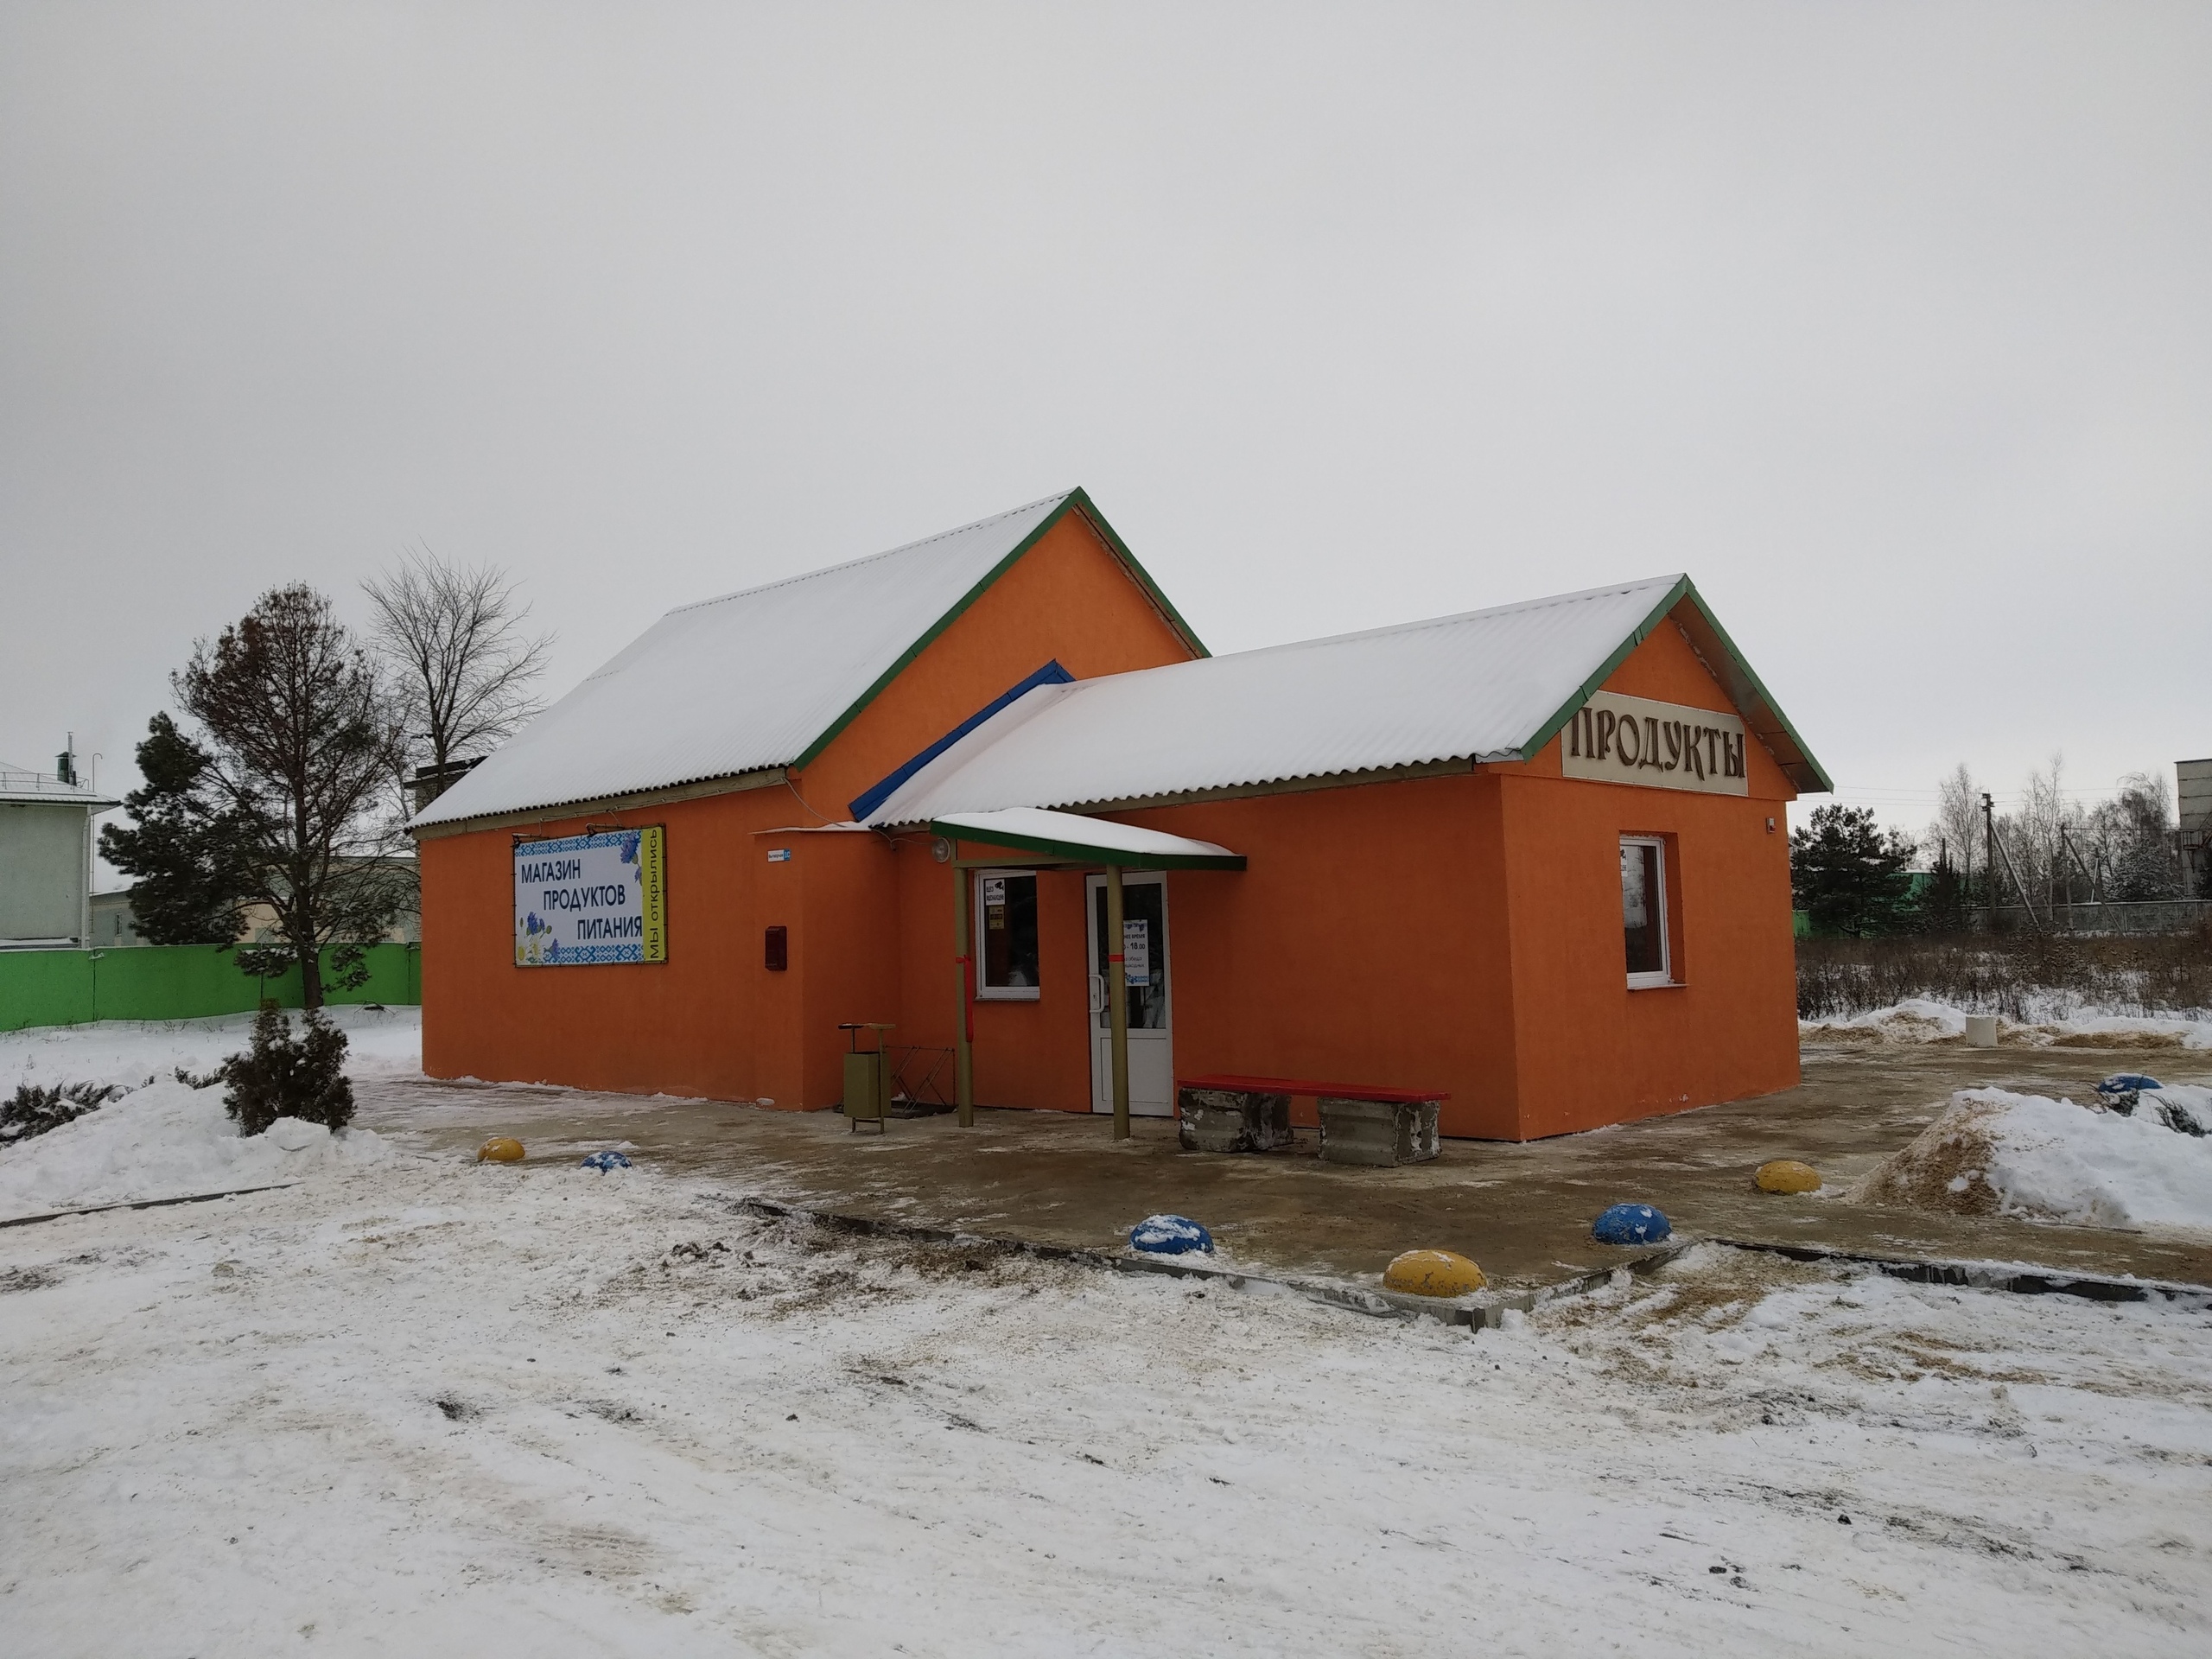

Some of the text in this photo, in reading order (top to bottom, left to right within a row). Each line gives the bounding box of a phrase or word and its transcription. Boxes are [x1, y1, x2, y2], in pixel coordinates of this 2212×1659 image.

[1571, 707, 1745, 781] ПРОДУКТЫ
[521, 859, 581, 883] МАГАЗИН
[543, 884, 626, 912] ПРОДУКТОВ
[577, 916, 642, 939] ПИТАНИЯ
